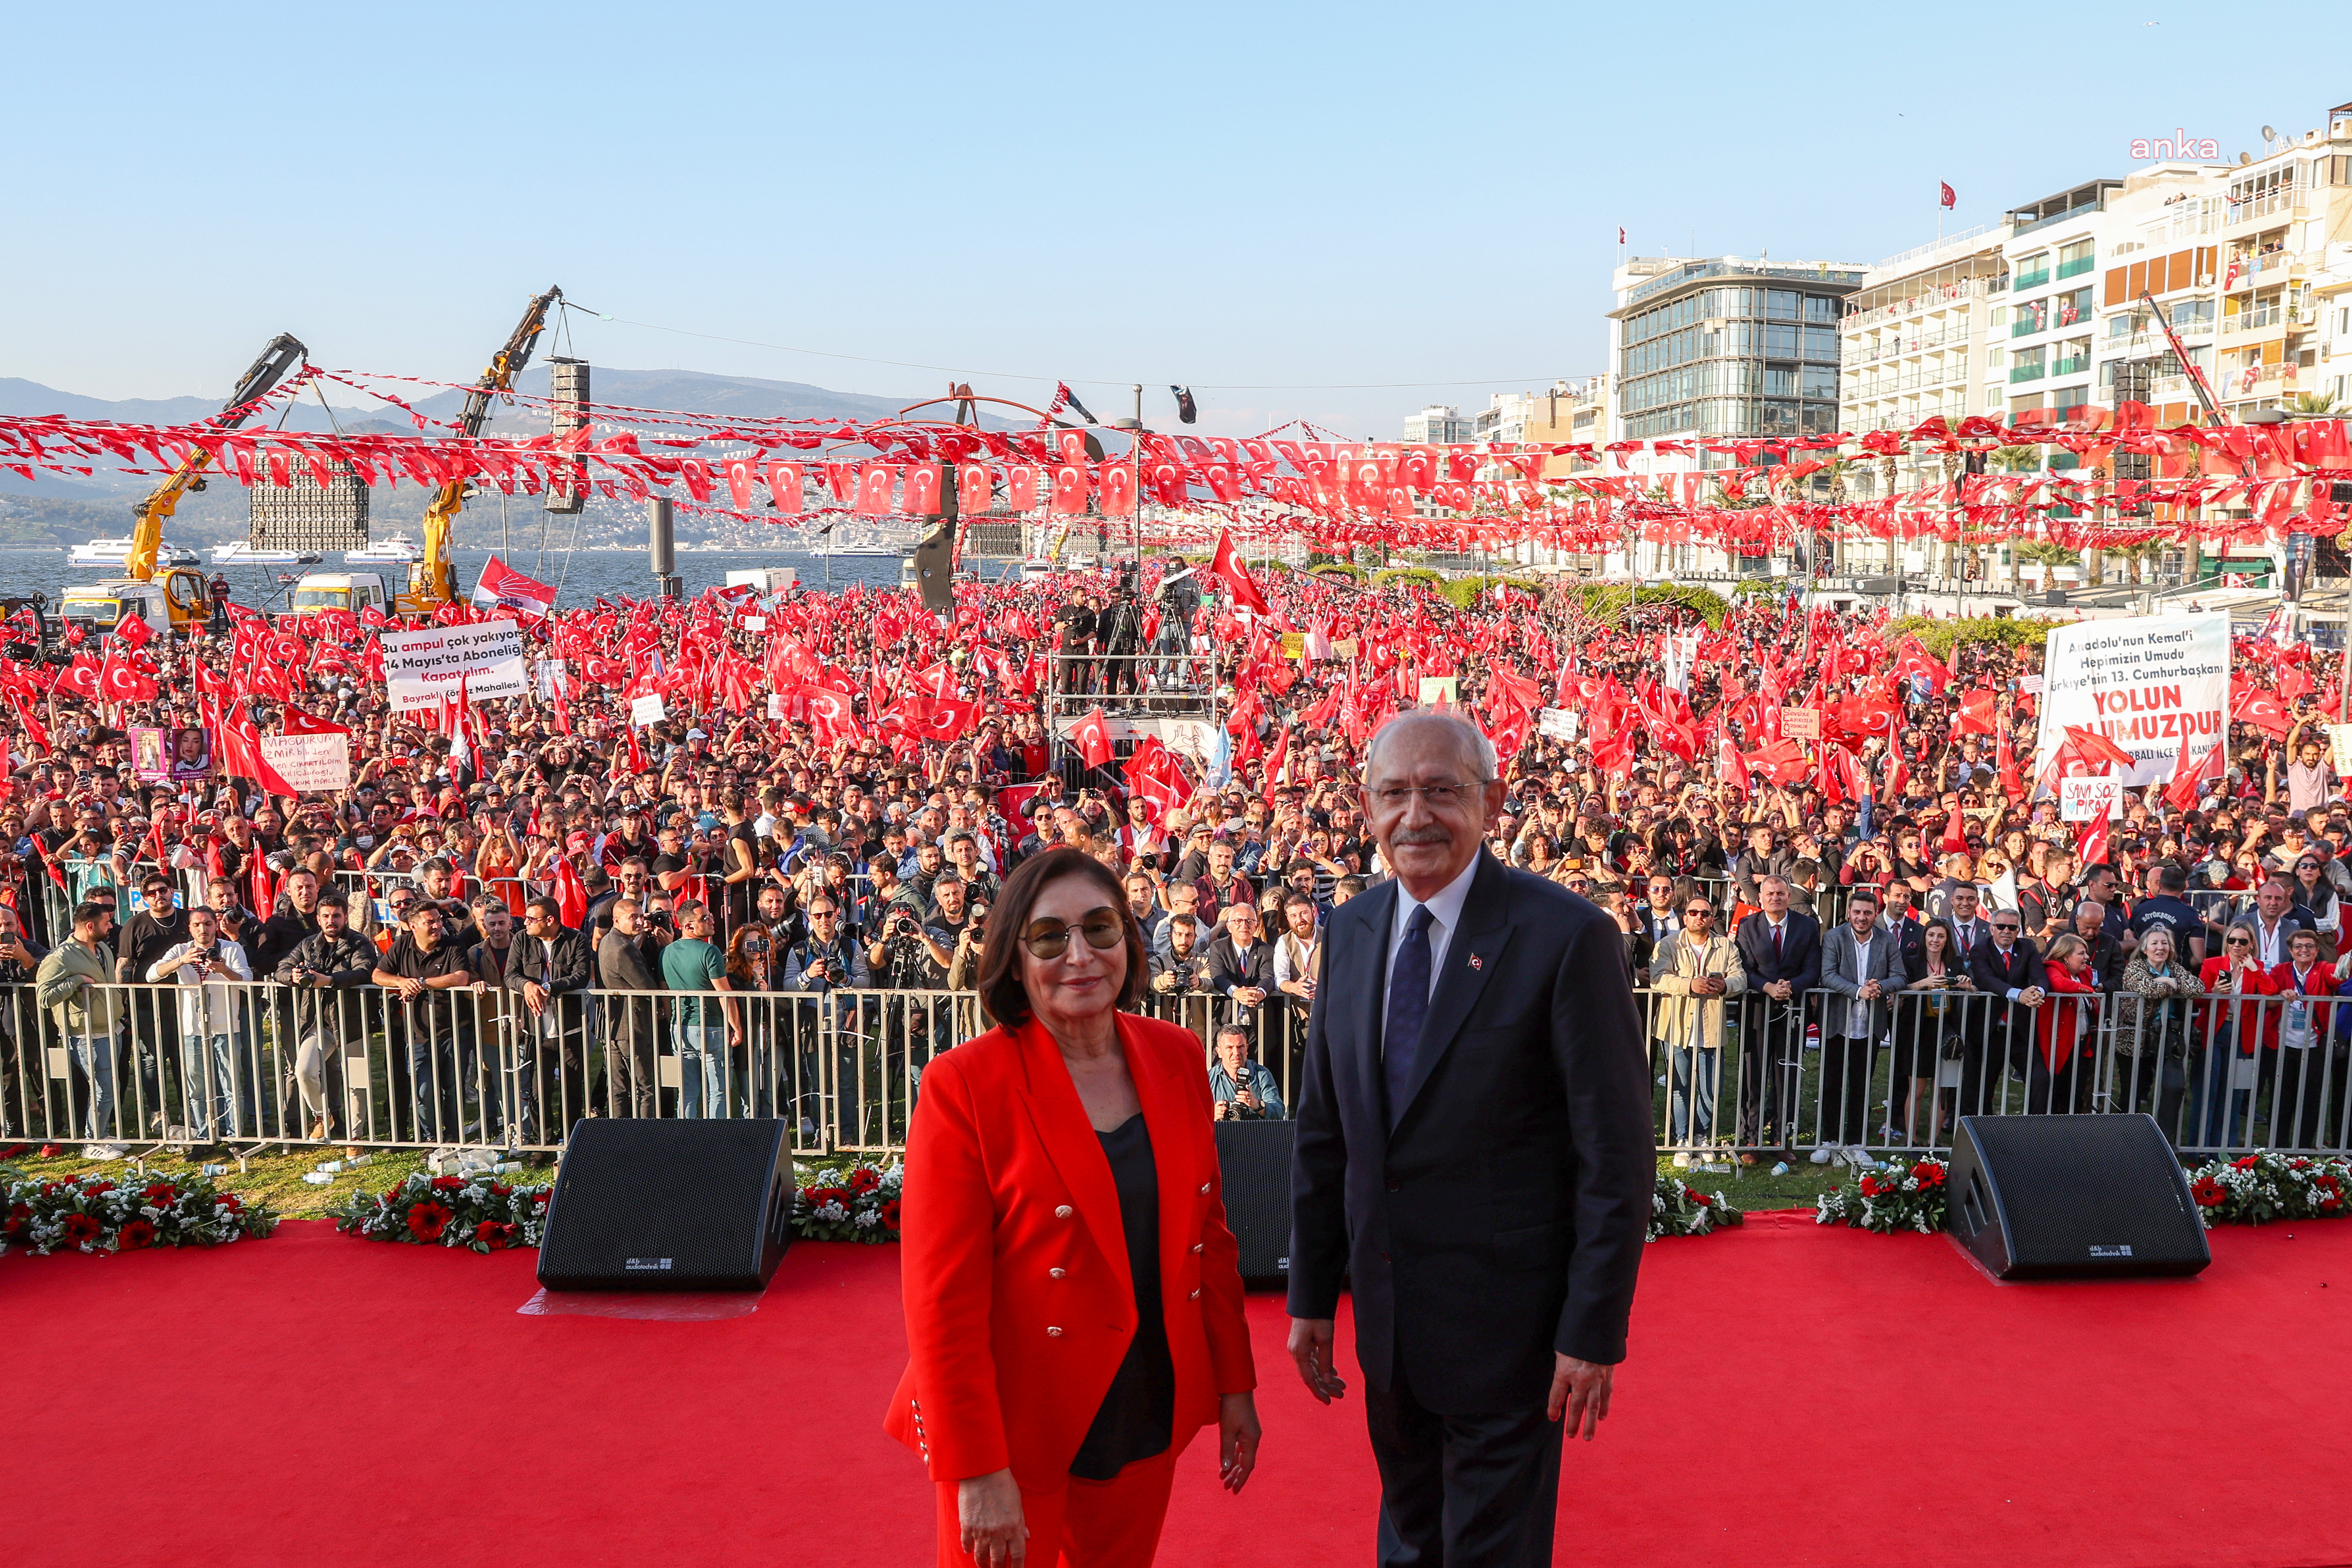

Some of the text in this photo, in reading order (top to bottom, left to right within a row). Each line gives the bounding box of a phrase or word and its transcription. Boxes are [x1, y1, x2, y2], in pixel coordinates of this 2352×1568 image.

[401, 637, 444, 652] ampul
[447, 635, 470, 650] çok
[2069, 630, 2194, 653] Anadolu'nun Kemal'i
[403, 654, 459, 669] Mayıs'ta
[2081, 649, 2185, 669] Hepimizin Umudu
[2051, 675, 2107, 691] ürkiye'nin
[2111, 671, 2128, 684] 13.
[2133, 662, 2224, 680] Cumhurbaşkanı
[476, 680, 520, 693] Mahallesi
[2093, 685, 2182, 715] YOLUN
[2066, 782, 2118, 799] SANA SÖZ
